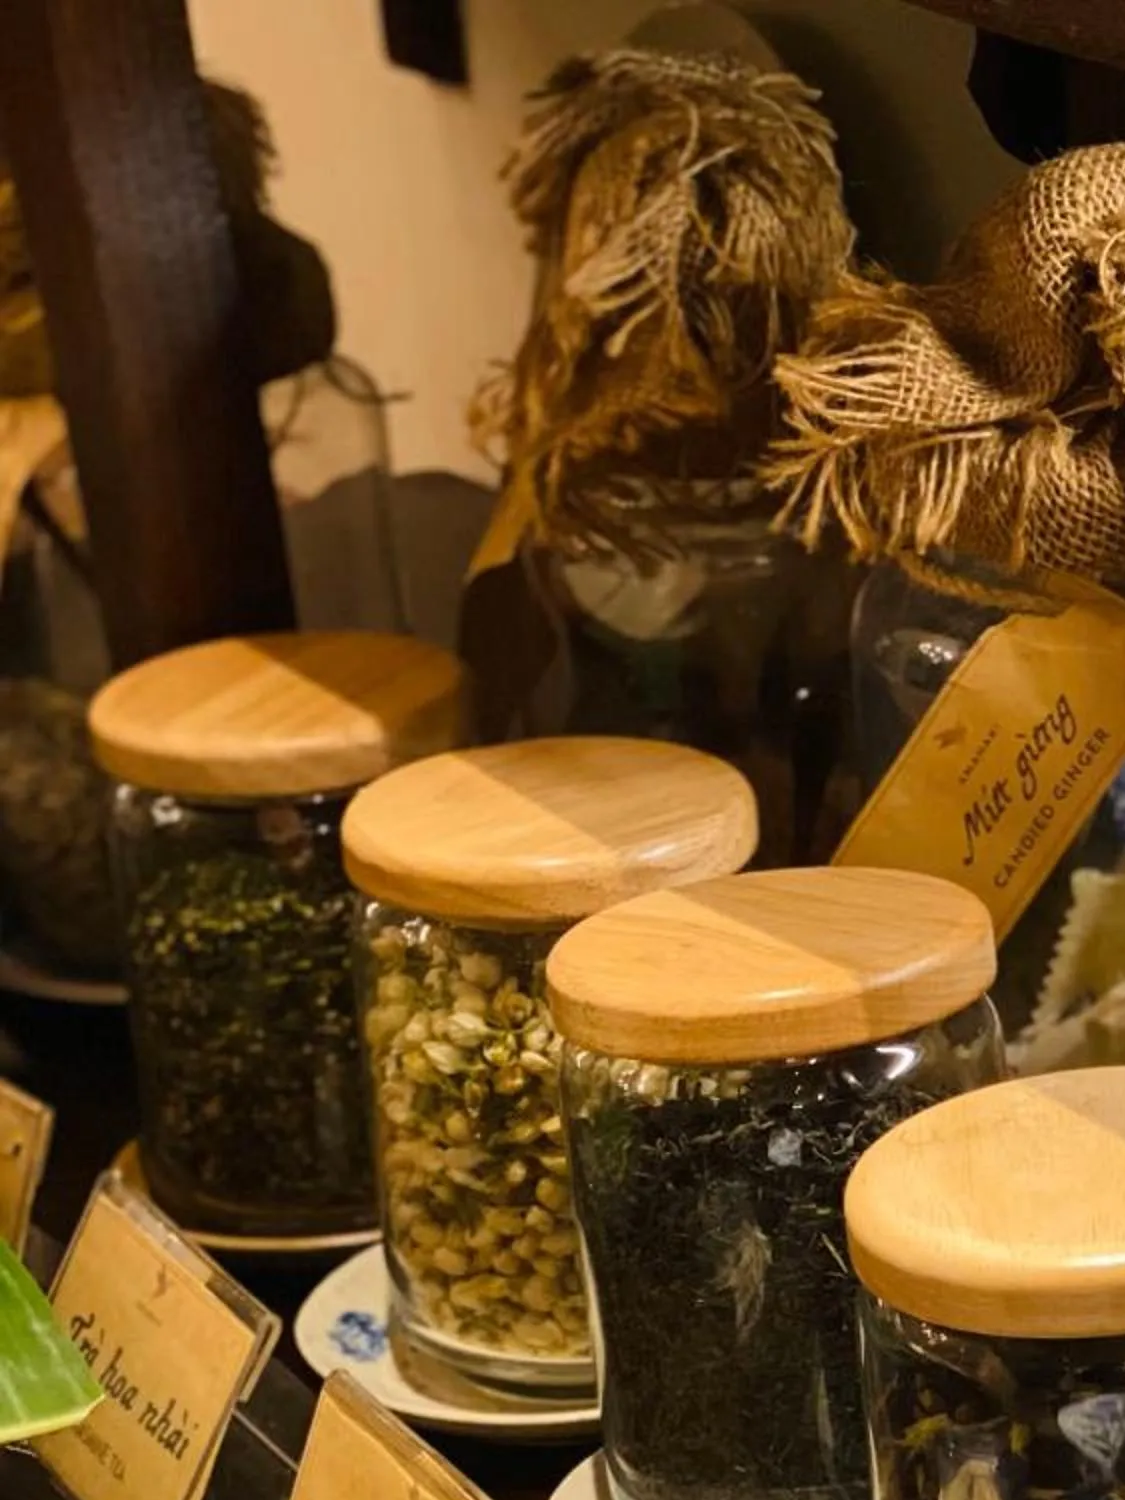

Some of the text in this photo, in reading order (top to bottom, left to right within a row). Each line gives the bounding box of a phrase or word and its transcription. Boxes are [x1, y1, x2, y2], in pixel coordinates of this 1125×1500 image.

[993, 727, 1111, 888] CANDIED GINGER
[99, 1346, 139, 1412] hoa
